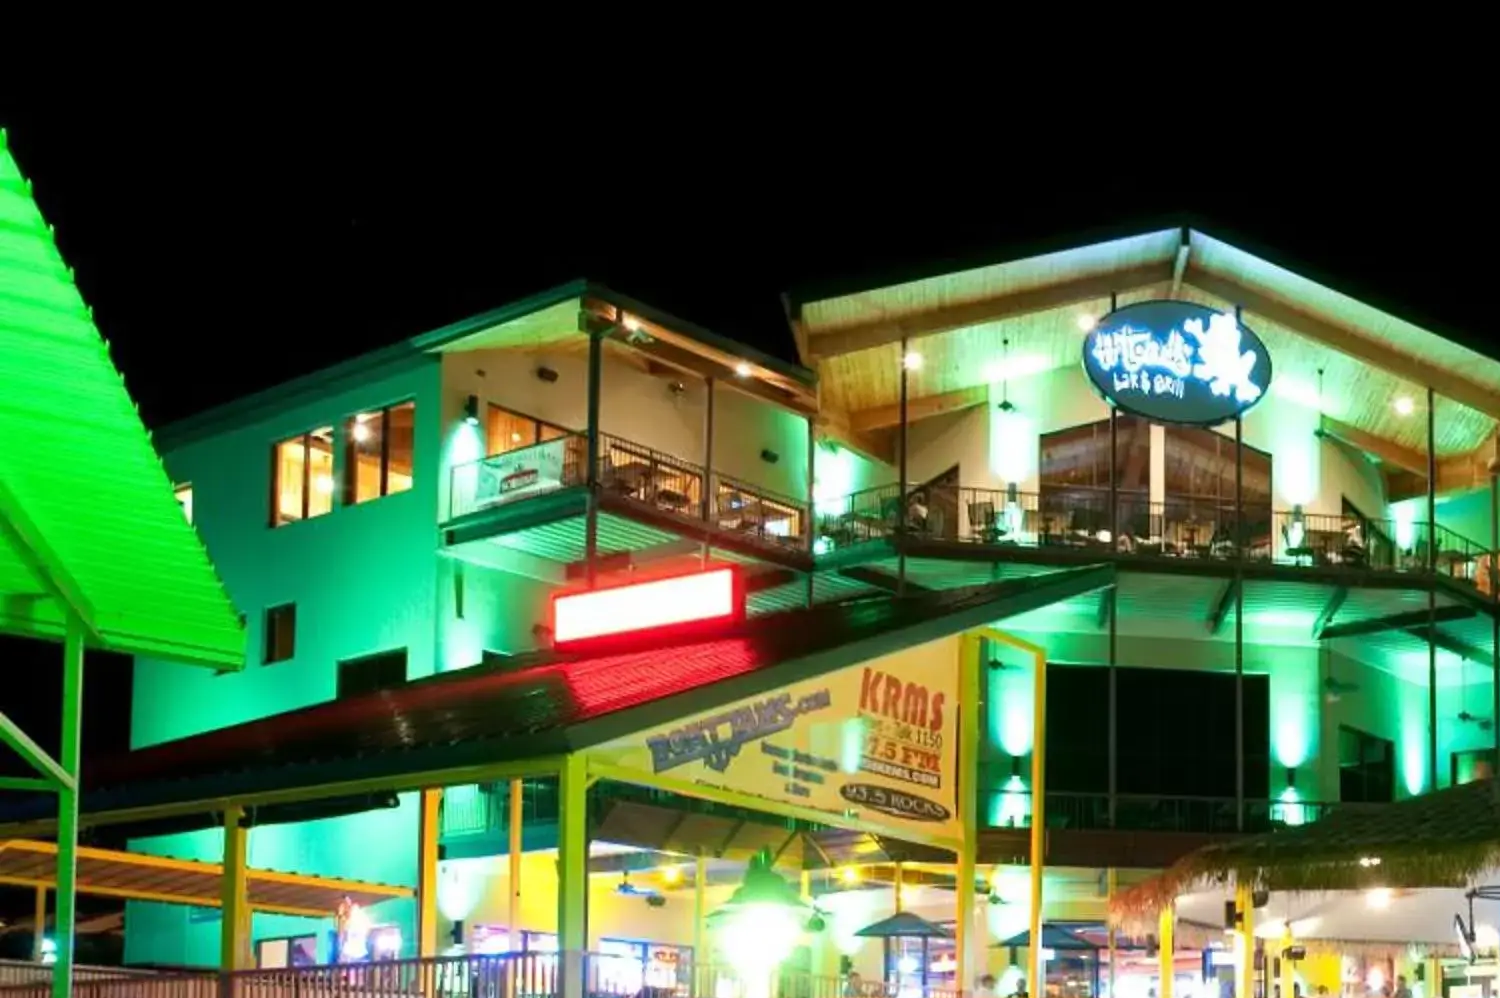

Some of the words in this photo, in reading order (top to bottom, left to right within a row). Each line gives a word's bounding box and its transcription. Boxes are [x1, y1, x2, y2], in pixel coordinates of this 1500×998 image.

[859, 667, 945, 732] KRMS
[915, 727, 943, 751] 1150
[901, 746, 941, 772] FM
[890, 794, 946, 818] ROCKS
